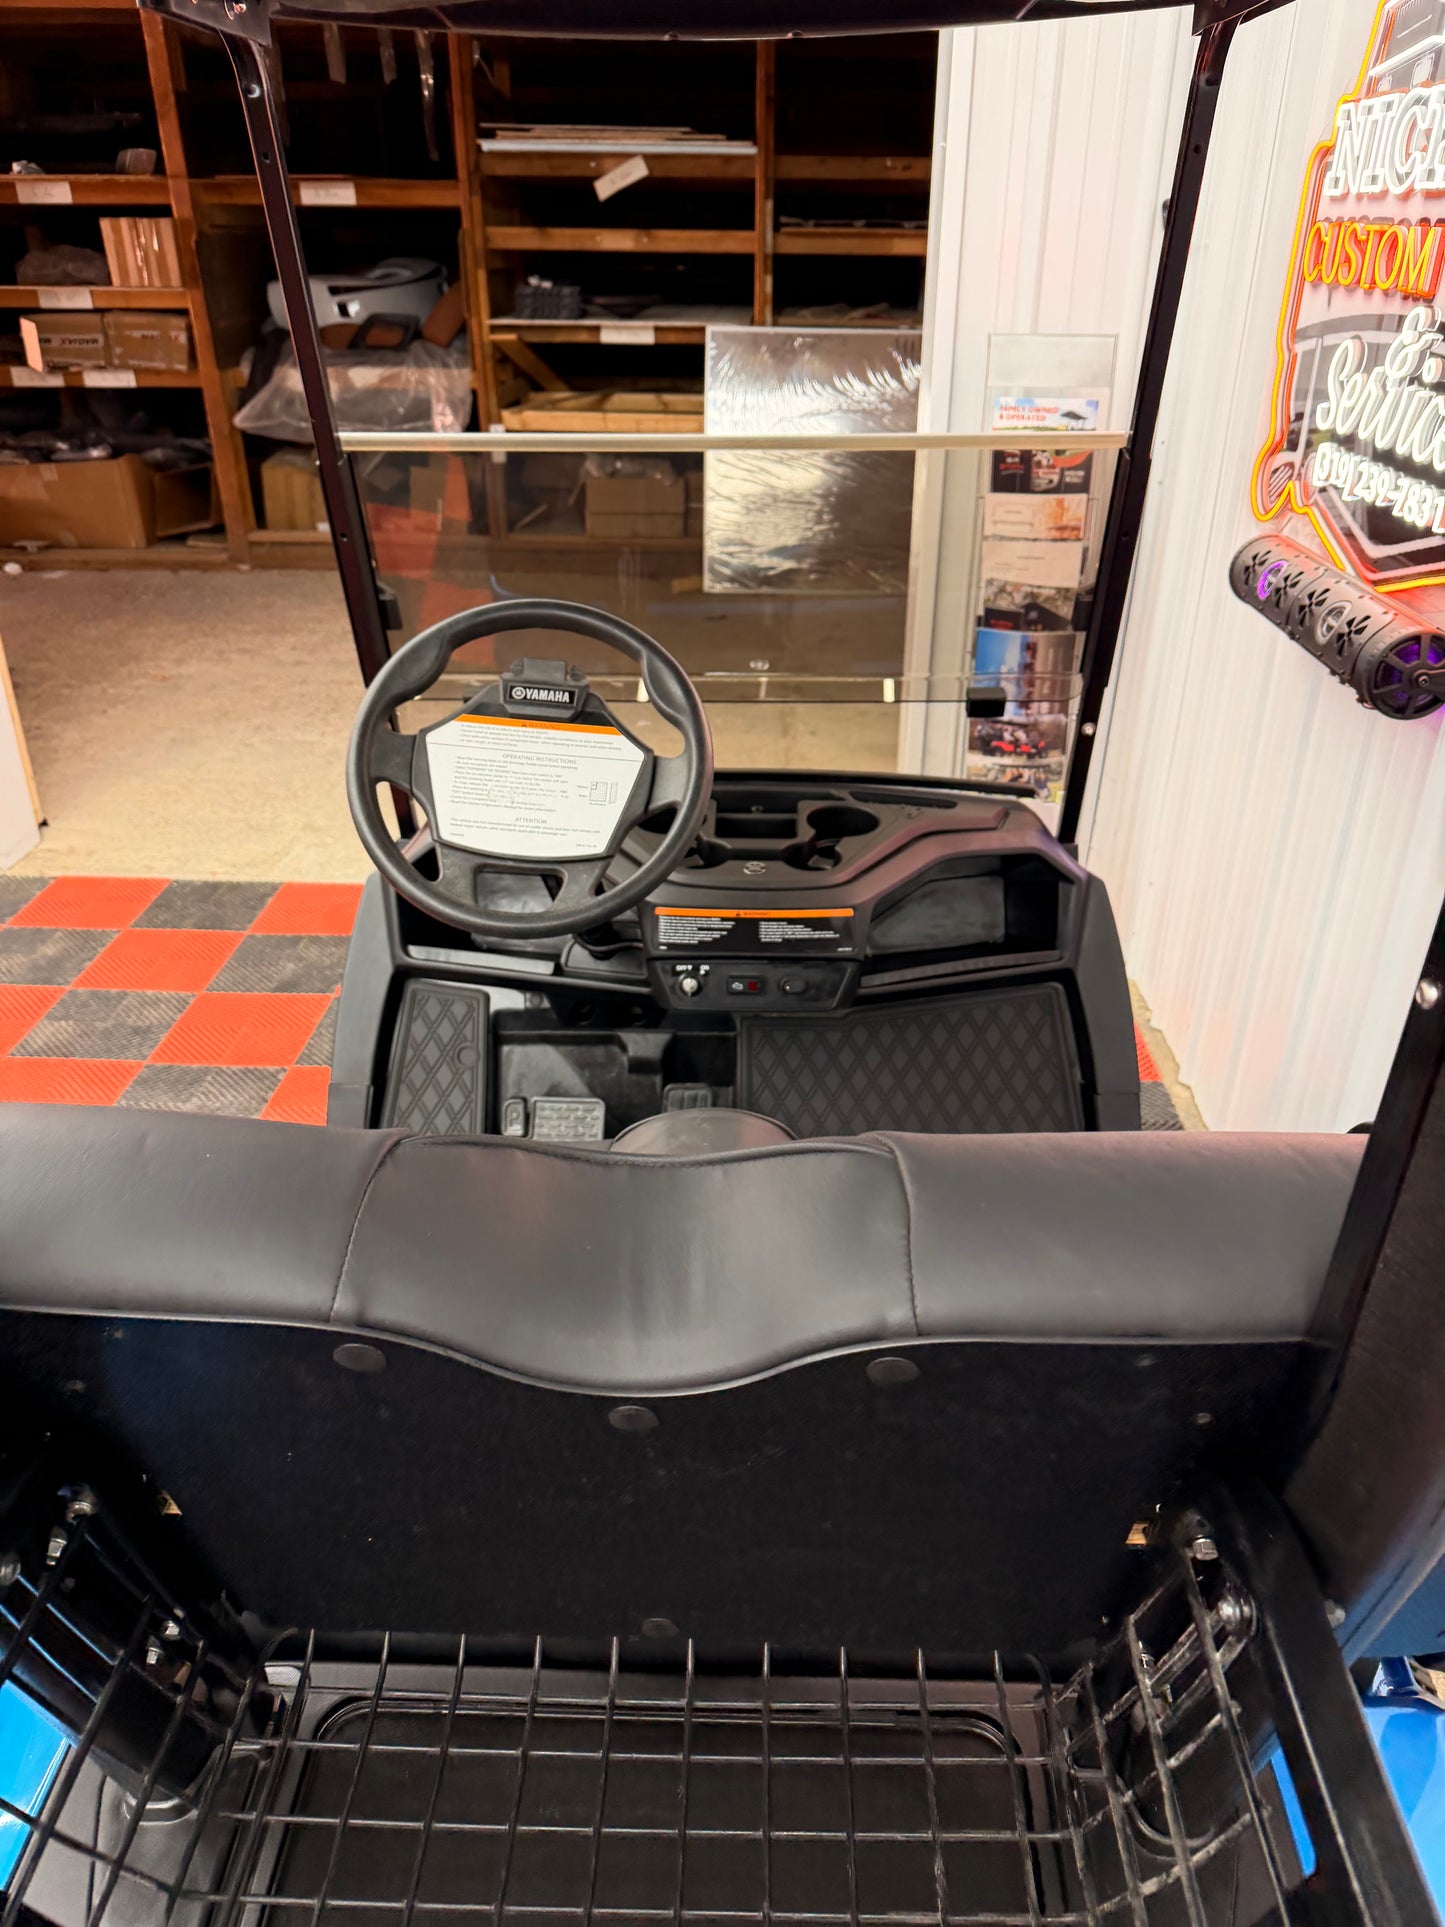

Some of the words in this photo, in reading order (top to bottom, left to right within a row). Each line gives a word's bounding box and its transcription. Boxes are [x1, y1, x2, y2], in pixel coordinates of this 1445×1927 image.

[1303, 220, 1441, 298] CUSTOM
[1383, 305, 1444, 380] &
[525, 688, 570, 703] YAMAHA
[502, 753, 535, 762] OPERATING
[536, 755, 577, 765] INSTRUCTIONS
[515, 817, 548, 825] ATTENTION
